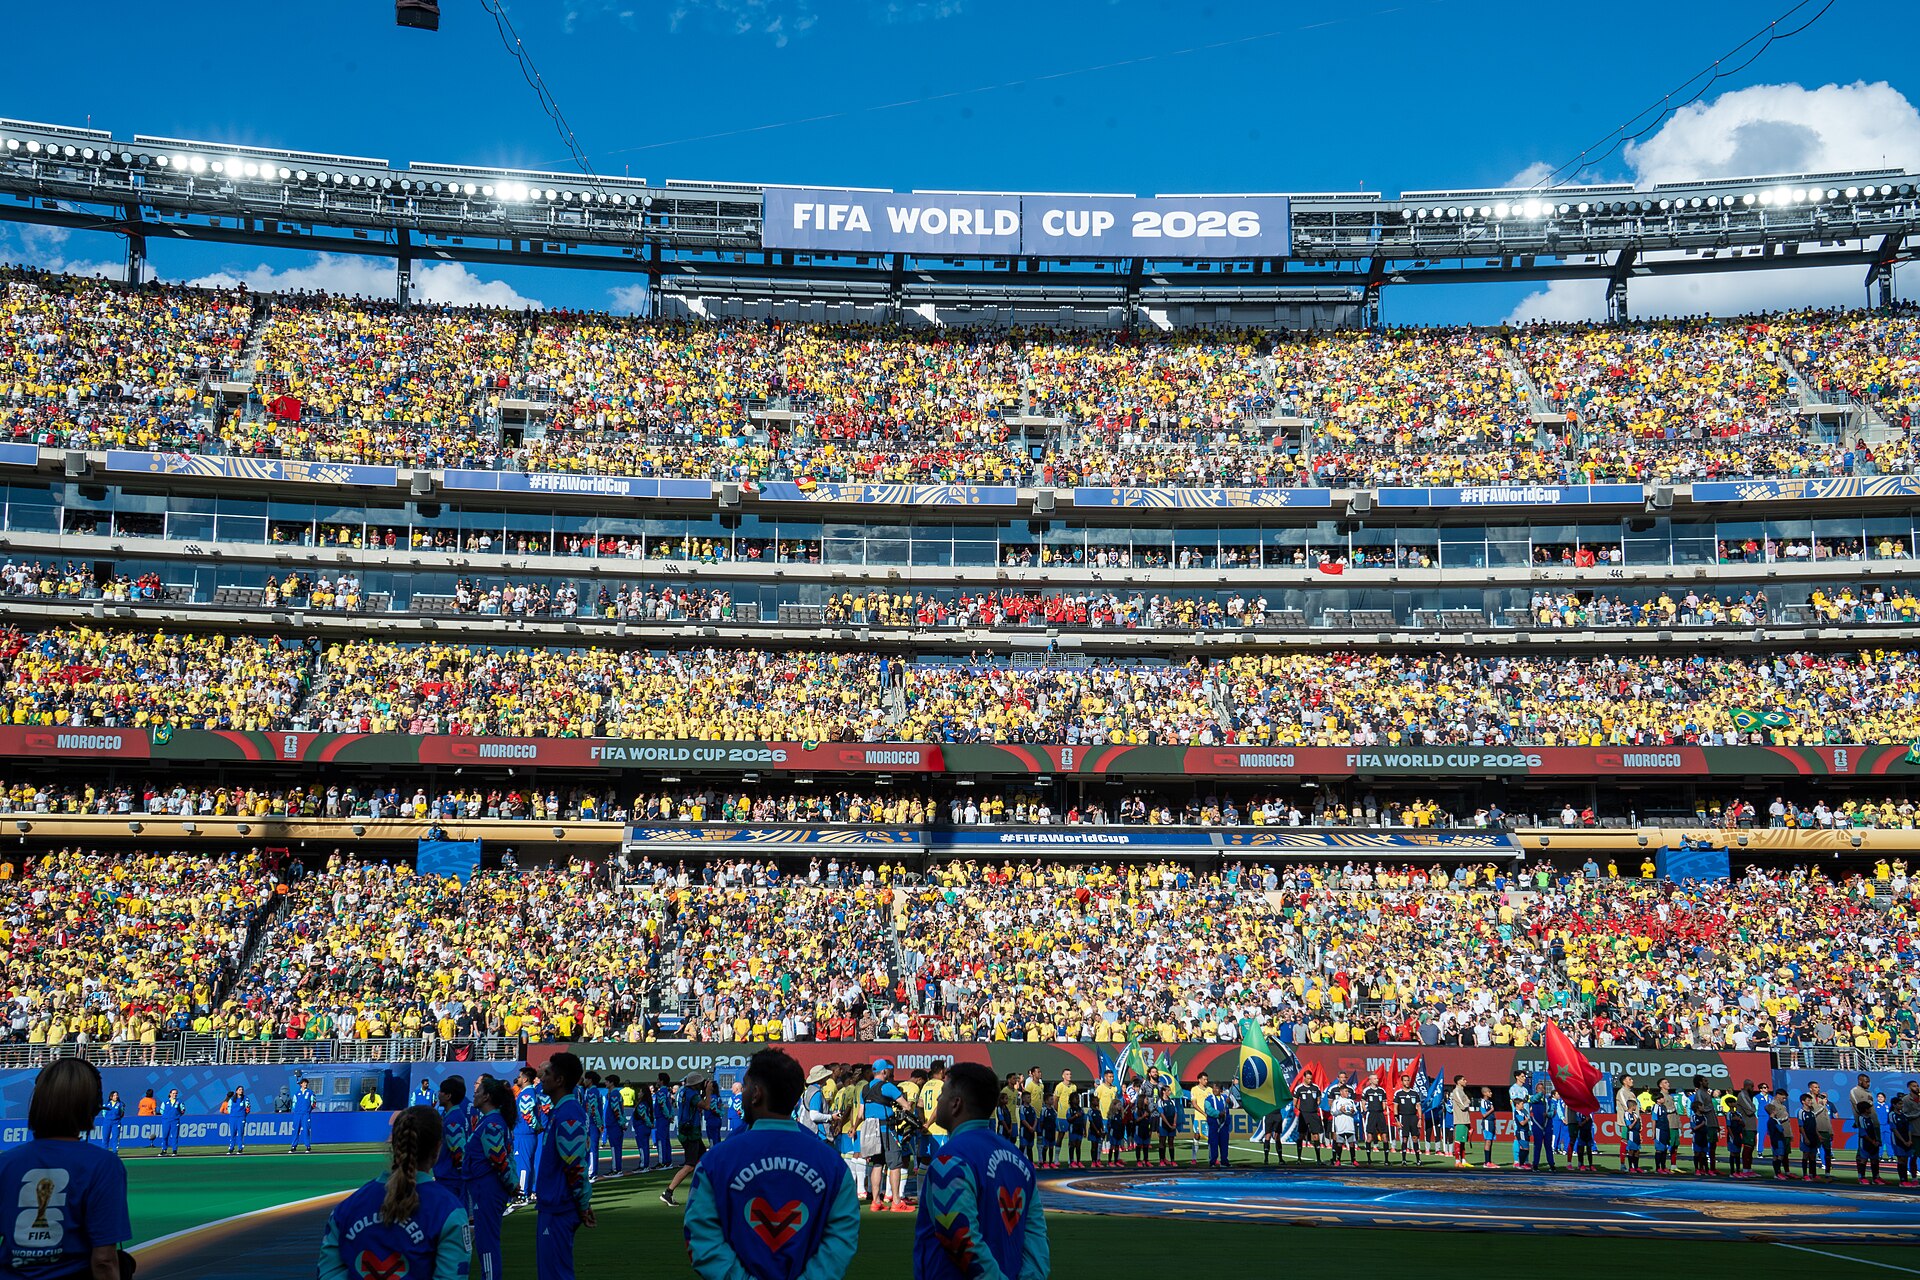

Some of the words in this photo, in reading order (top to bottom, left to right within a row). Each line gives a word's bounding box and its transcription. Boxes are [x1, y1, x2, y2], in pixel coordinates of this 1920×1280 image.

[793, 203, 871, 232] FIFA
[886, 206, 1020, 236] WORLD
[1042, 209, 1114, 237] CUP
[1131, 211, 1261, 238] 2026
[529, 475, 631, 494] #FIFAWorldCup
[1460, 487, 1560, 504] #FIFAWorldCup
[57, 734, 122, 750] MOROCCO
[479, 743, 537, 759] MOROCCO
[590, 746, 626, 761] FIFA
[629, 747, 690, 761] WORLD
[692, 748, 726, 761] CUP
[728, 748, 787, 762] 2026
[865, 750, 920, 765] MOROCCO
[1240, 753, 1295, 768] MOROCCO
[1346, 754, 1382, 767] FIFA
[1383, 754, 1444, 767] WORLD
[1446, 754, 1480, 767] CUP
[1482, 754, 1542, 767] 2026
[1623, 753, 1681, 768] MOROCCO
[1000, 833, 1130, 845] #FIFAWorldCup
[580, 1056, 607, 1071] IFA
[609, 1056, 674, 1070] WORLD
[676, 1056, 712, 1070] CUP
[715, 1056, 752, 1067] 20
[1517, 1060, 1548, 1072] FIF
[1625, 1062, 1661, 1076] CUP
[1664, 1063, 1728, 1078] 2026
[924, 1089, 933, 1110] 13
[3, 1127, 28, 1142] GET
[986, 1148, 1031, 1182] VOLUNTEER
[729, 1157, 826, 1194] VOLUNTEER
[28, 1231, 51, 1241] FIFA
[345, 1212, 425, 1245] VOLUEER
[12, 1249, 44, 1257] WORLD
[44, 1247, 63, 1256] CUP
